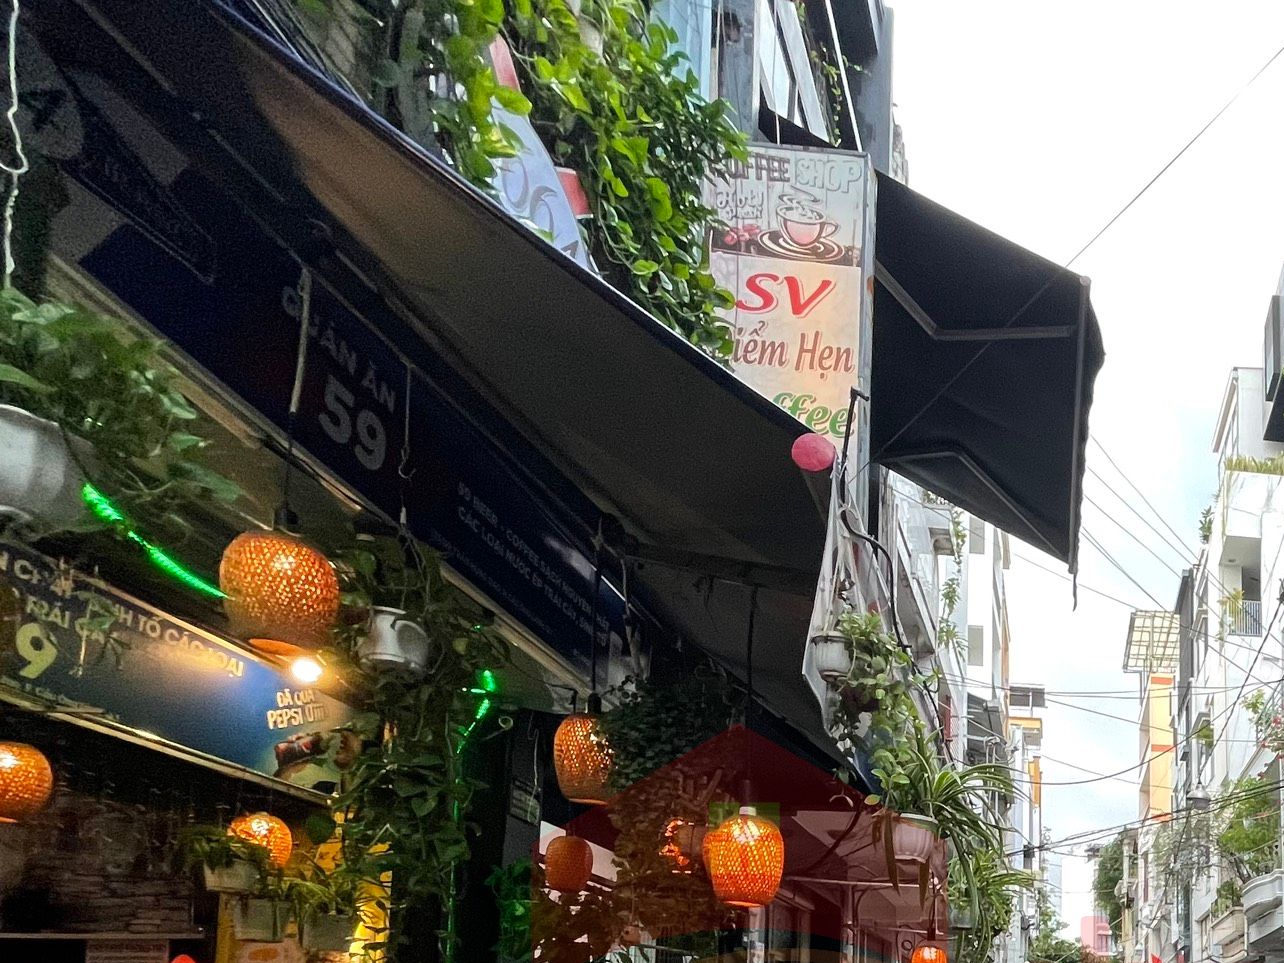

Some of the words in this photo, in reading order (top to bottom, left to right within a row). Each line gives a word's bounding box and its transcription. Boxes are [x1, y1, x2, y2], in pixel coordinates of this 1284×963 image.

[797, 157, 862, 194] SHOP
[735, 272, 836, 318] SV
[728, 320, 789, 368] iểm
[794, 330, 855, 380] Hẹn
[318, 373, 388, 472] 59
[266, 707, 304, 730] PEPSI
